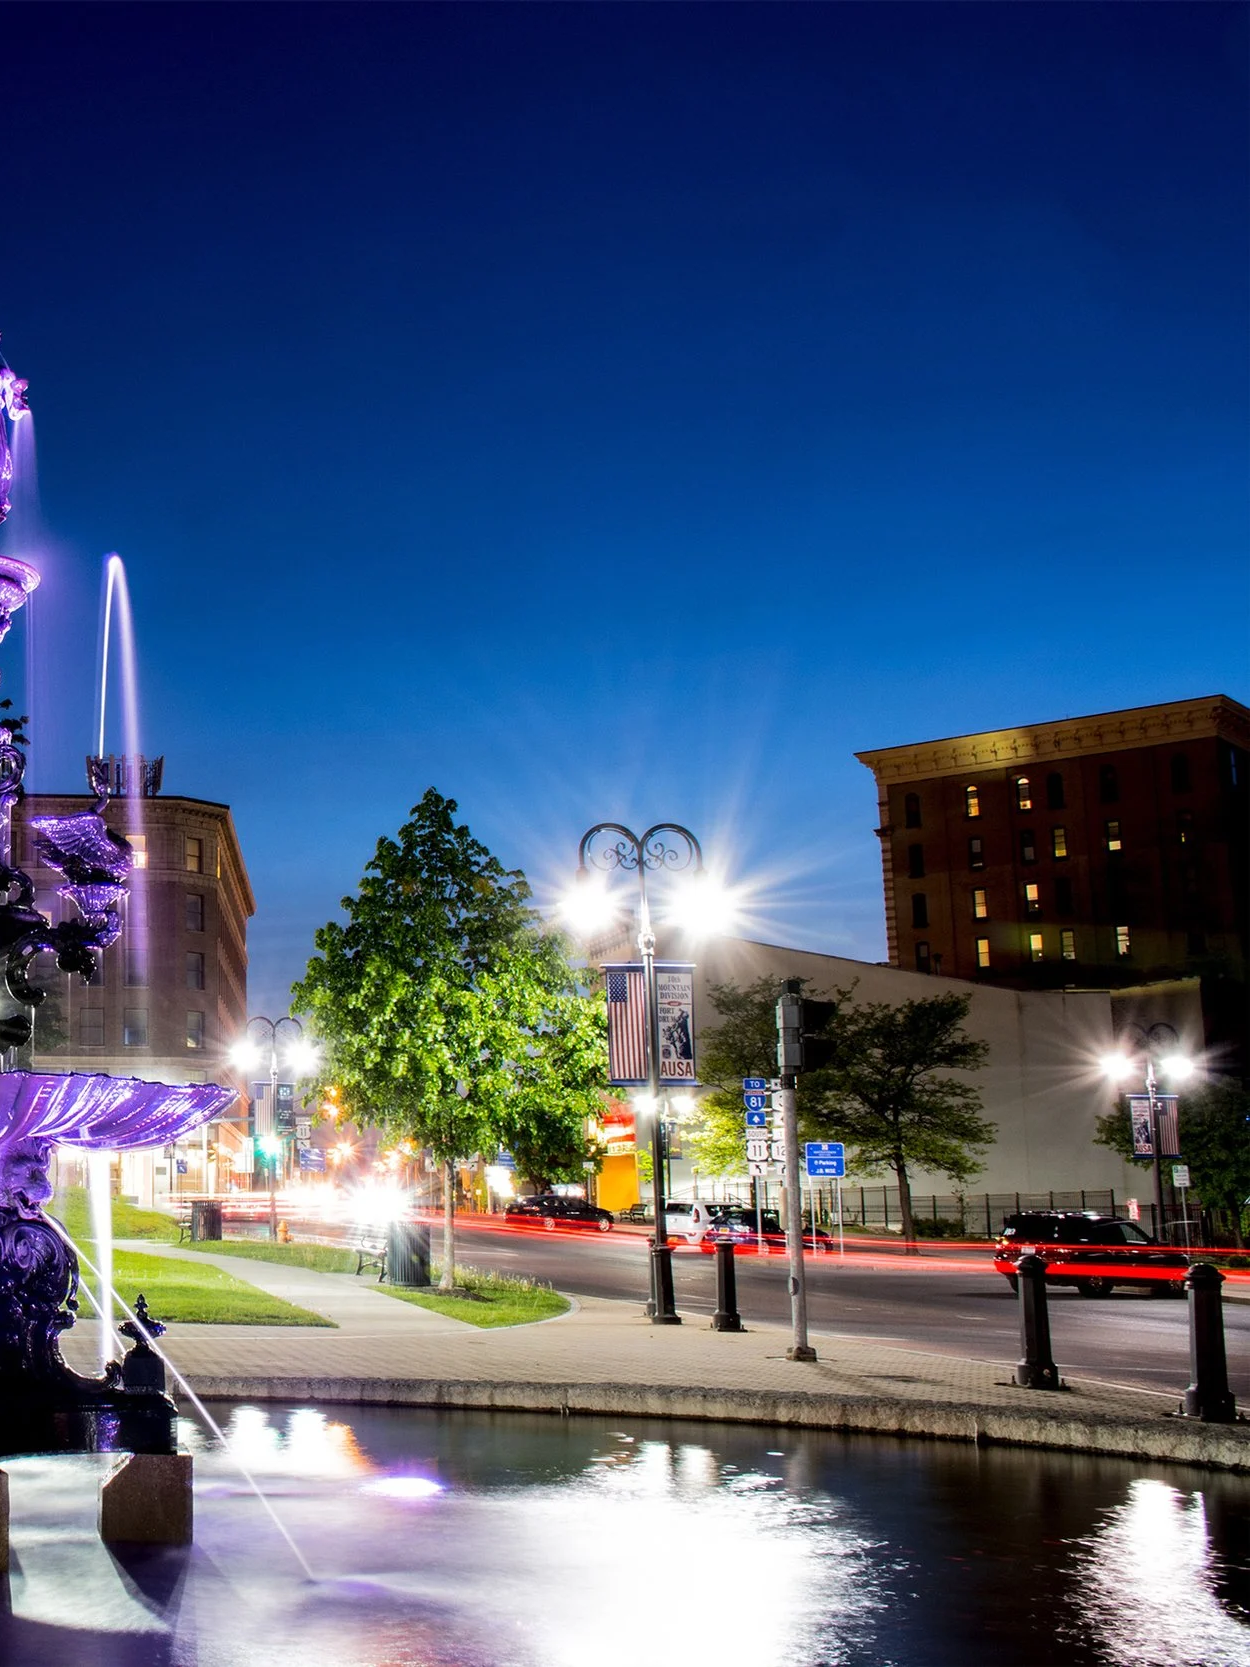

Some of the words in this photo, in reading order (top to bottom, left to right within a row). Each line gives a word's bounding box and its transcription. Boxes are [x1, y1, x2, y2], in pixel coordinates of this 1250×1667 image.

[660, 991, 689, 999] DIVISION
[659, 1007, 674, 1015] FORT
[661, 1060, 693, 1077] AUSA
[750, 1080, 761, 1088] TO
[750, 1096, 762, 1108] 81
[747, 1130, 766, 1138] SOUTH
[753, 1144, 762, 1157] 11
